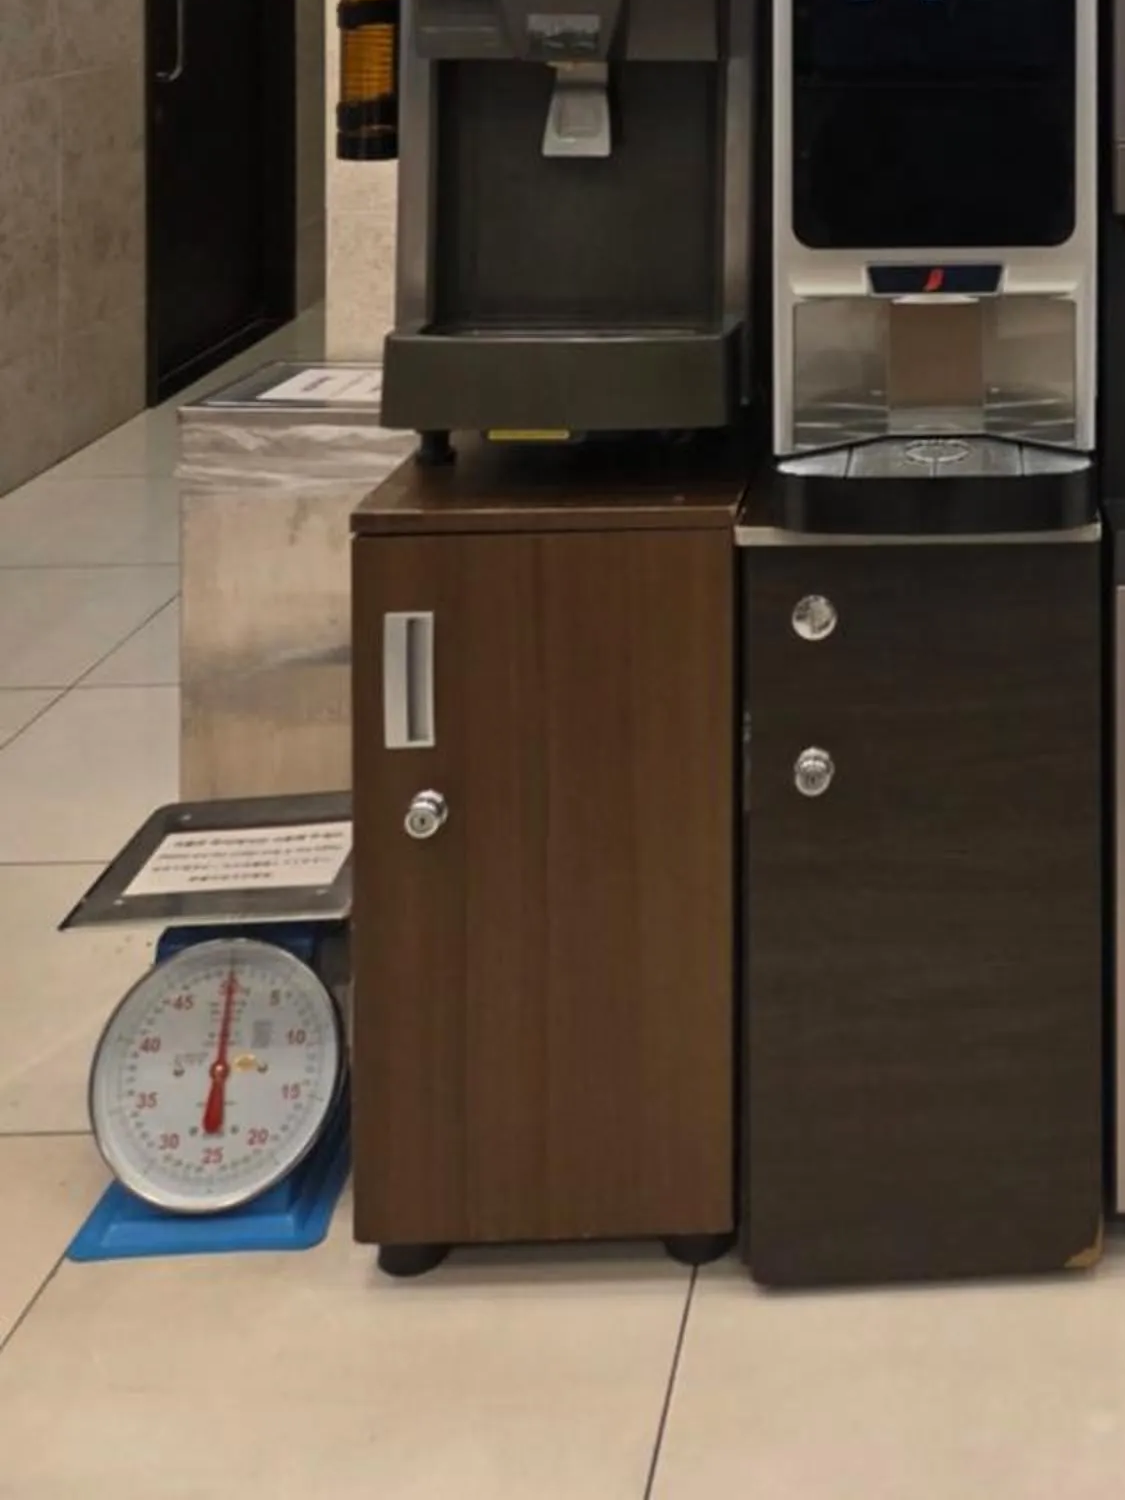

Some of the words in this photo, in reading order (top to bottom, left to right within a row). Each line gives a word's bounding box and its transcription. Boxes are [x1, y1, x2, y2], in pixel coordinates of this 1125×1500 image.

[172, 993, 194, 1011] 45
[139, 1037, 161, 1054] 40
[286, 1028, 306, 1045] 10
[135, 1092, 158, 1109] 35
[159, 1132, 181, 1151] 30
[247, 1128, 269, 1146] 20
[202, 1147, 223, 1165] 25
